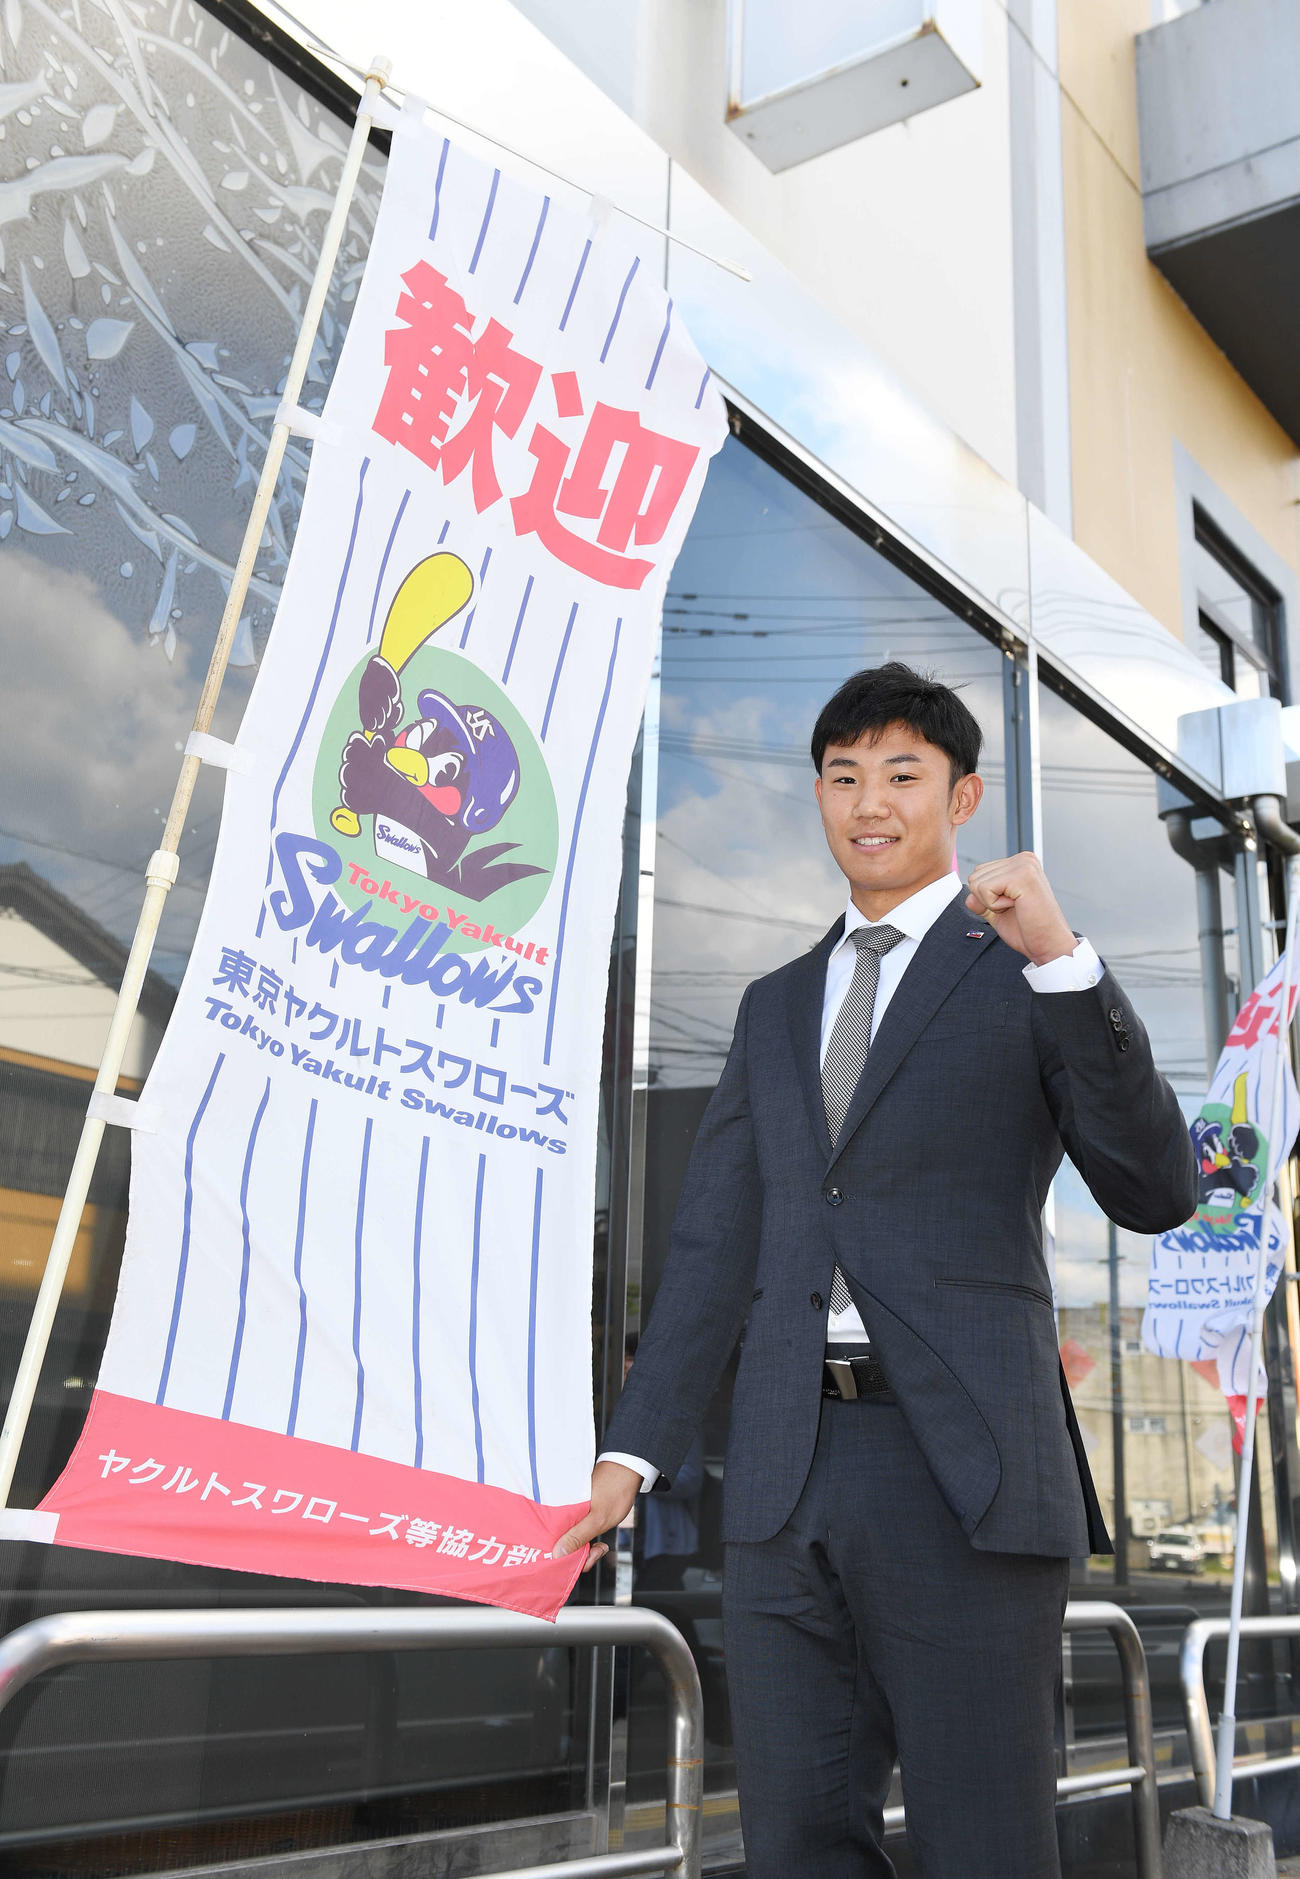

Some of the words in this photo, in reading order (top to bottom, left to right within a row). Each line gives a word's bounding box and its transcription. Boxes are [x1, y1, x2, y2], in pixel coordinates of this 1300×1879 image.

[371, 259, 701, 591] 歓迎
[347, 862, 439, 922] Tokyo
[445, 906, 550, 966] Yakult
[376, 824, 422, 854] Swallows
[269, 831, 543, 1014] Swallows
[204, 996, 284, 1058] Tokyo
[290, 1042, 392, 1101] Yakult
[400, 1088, 568, 1155] Swallows
[212, 945, 576, 1125] 東京ヤクルトスワローズ
[98, 1449, 553, 1568] ヤクルトスワローズ等協力部
